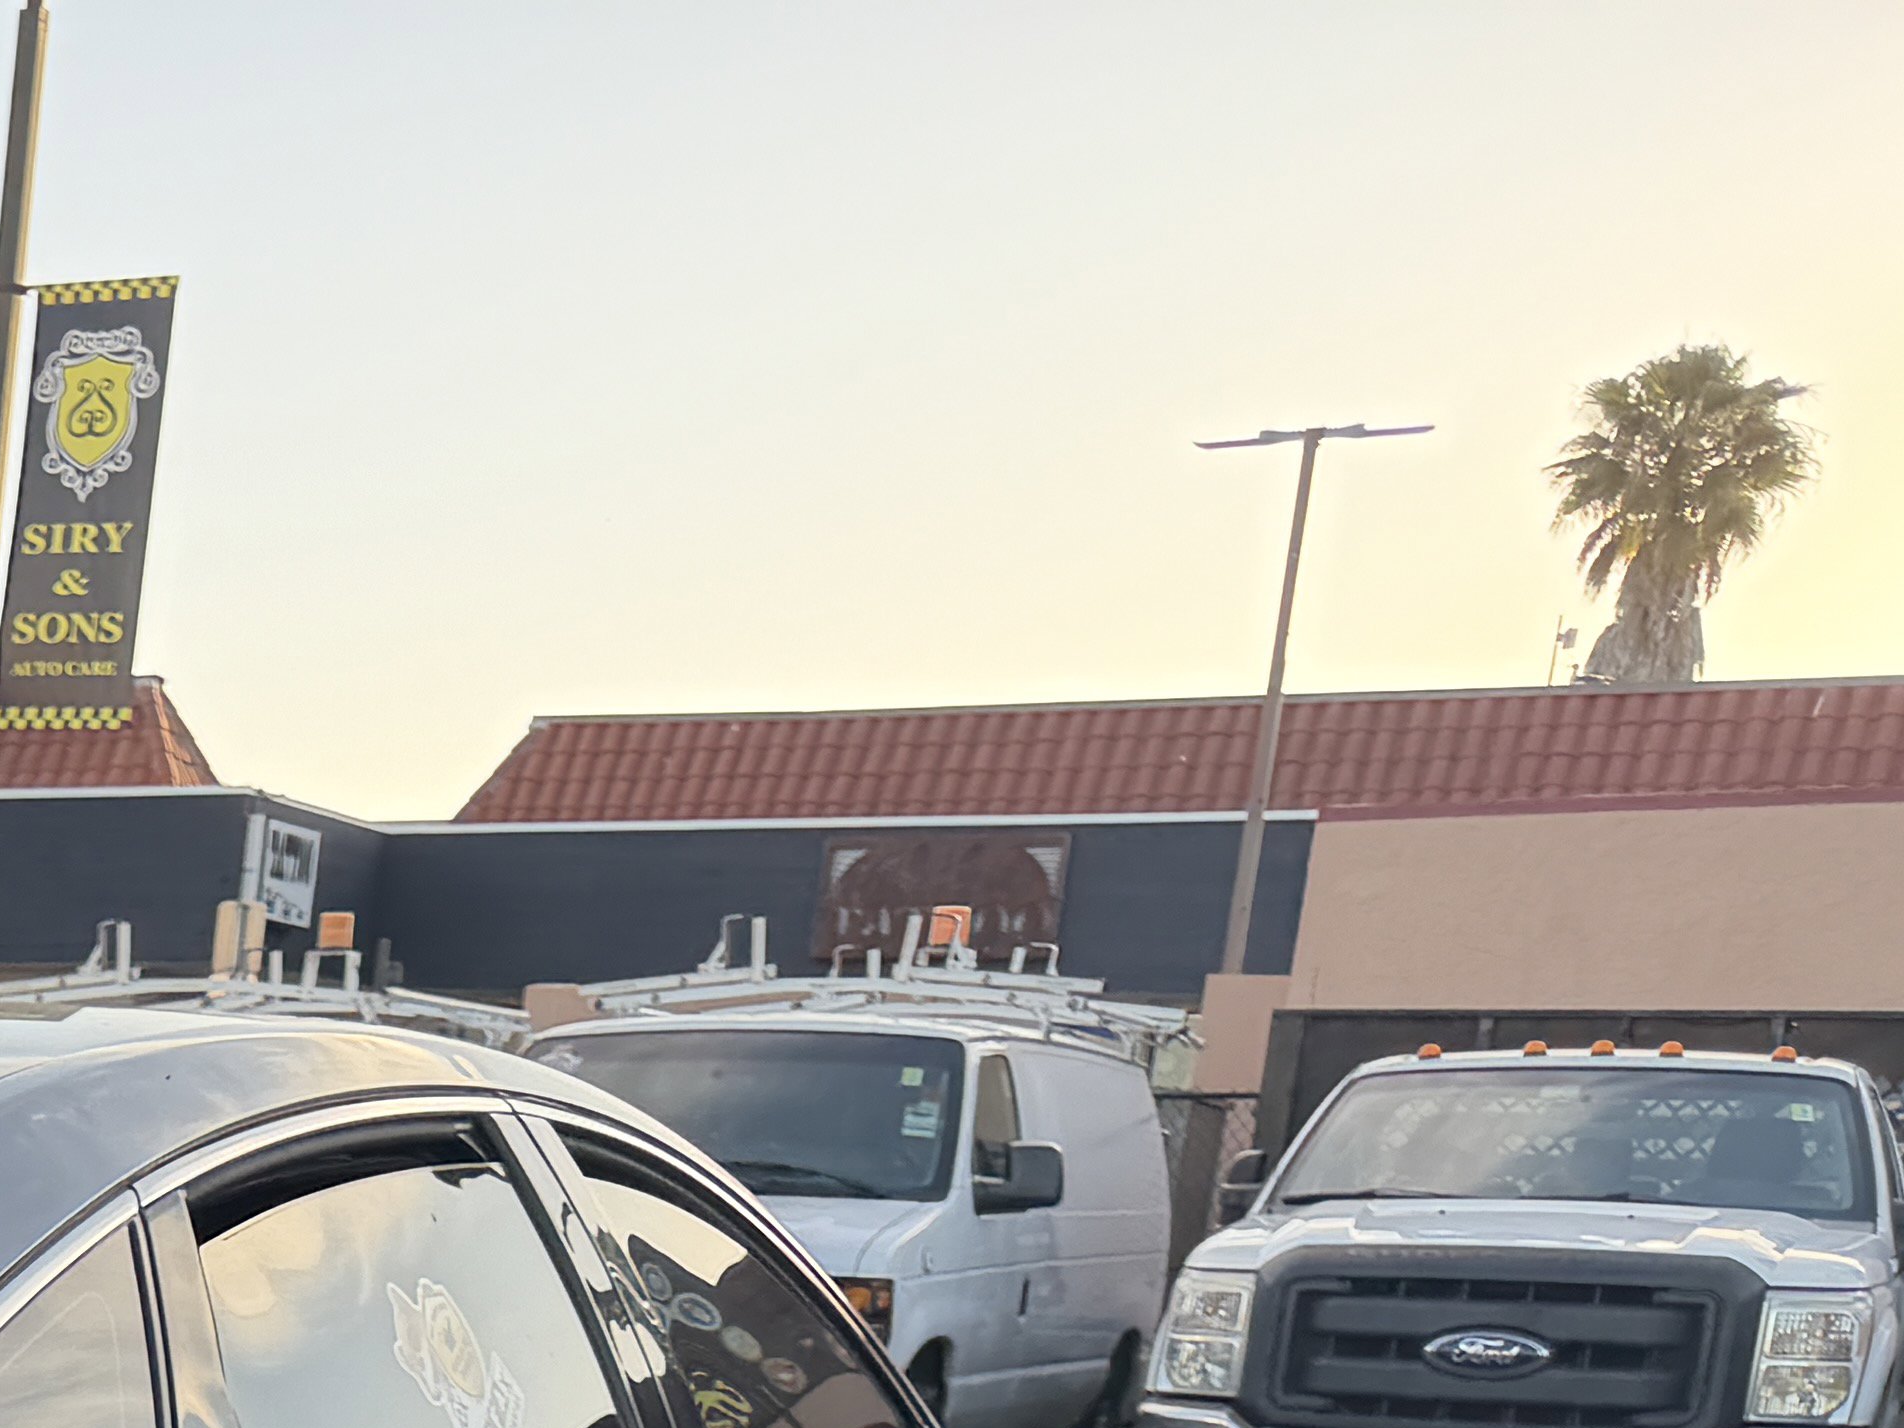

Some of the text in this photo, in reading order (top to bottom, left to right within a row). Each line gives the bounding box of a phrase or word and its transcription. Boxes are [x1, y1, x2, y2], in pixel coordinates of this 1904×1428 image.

[20, 520, 133, 555] SIRY
[51, 568, 91, 597] &
[10, 611, 125, 646] SONS
